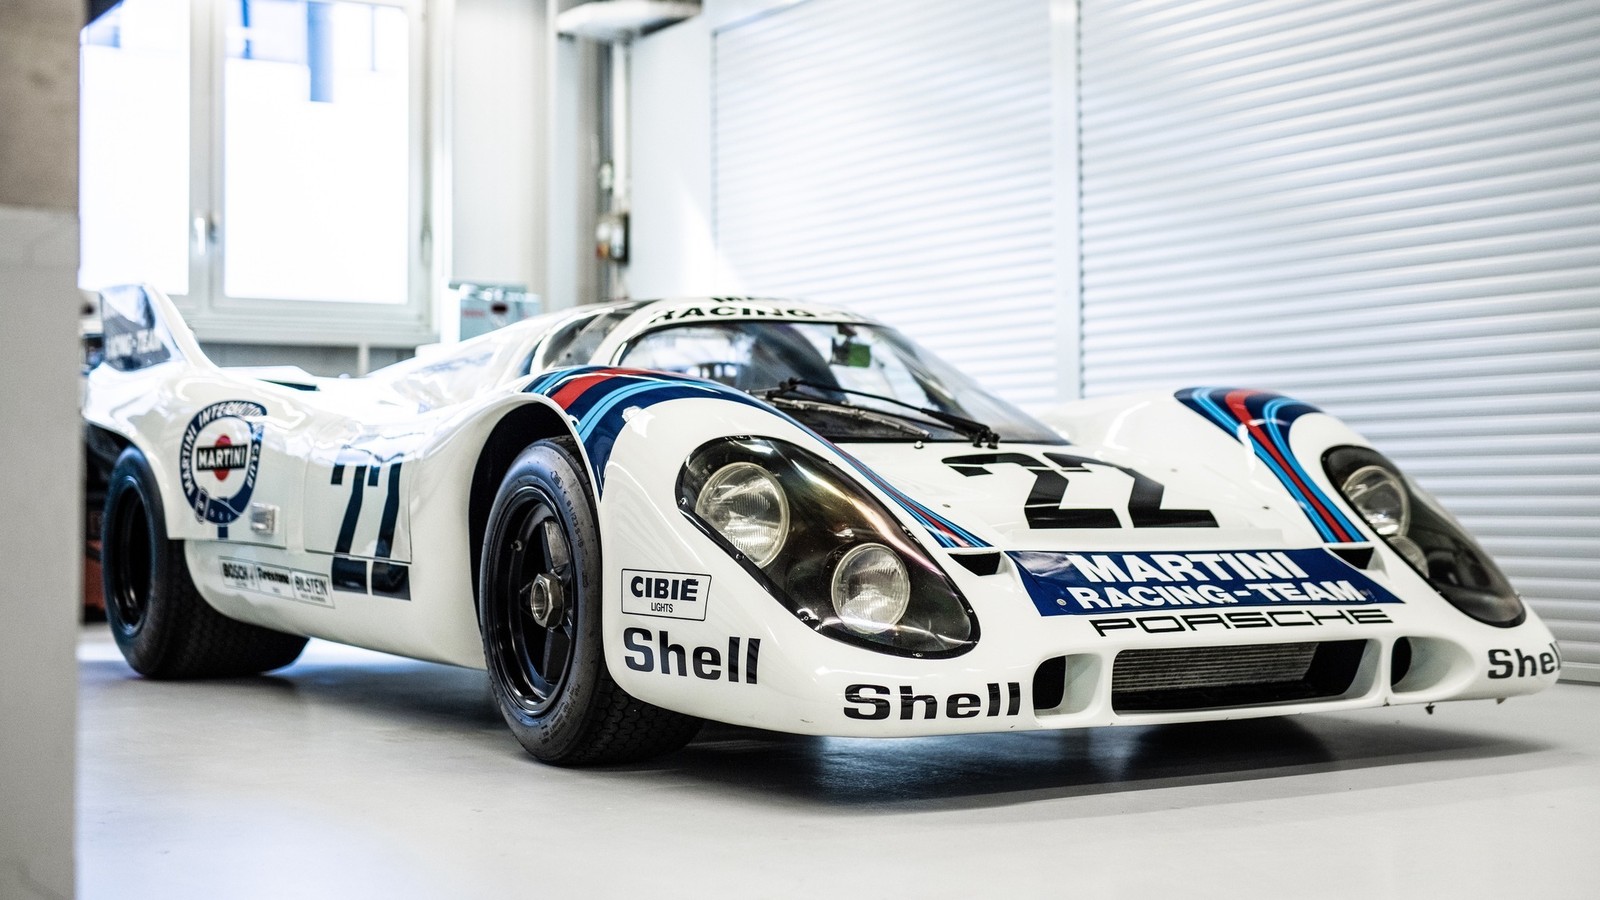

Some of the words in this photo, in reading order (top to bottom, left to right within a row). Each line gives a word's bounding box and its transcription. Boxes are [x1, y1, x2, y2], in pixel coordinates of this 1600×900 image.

[182, 425, 198, 497] MARTINI
[198, 447, 246, 469] MARTINI
[941, 452, 1219, 530] 22
[331, 461, 411, 601] 22
[222, 563, 249, 580] BOSCH
[1065, 551, 1309, 583] MARTINI
[294, 575, 328, 596] BILSTEIN
[1066, 580, 1366, 610] RACING-TEAM
[650, 602, 674, 614] LIGHTS
[1088, 608, 1394, 637] PORSCHE
[623, 626, 761, 685] Shell
[843, 682, 1021, 721] Shell
